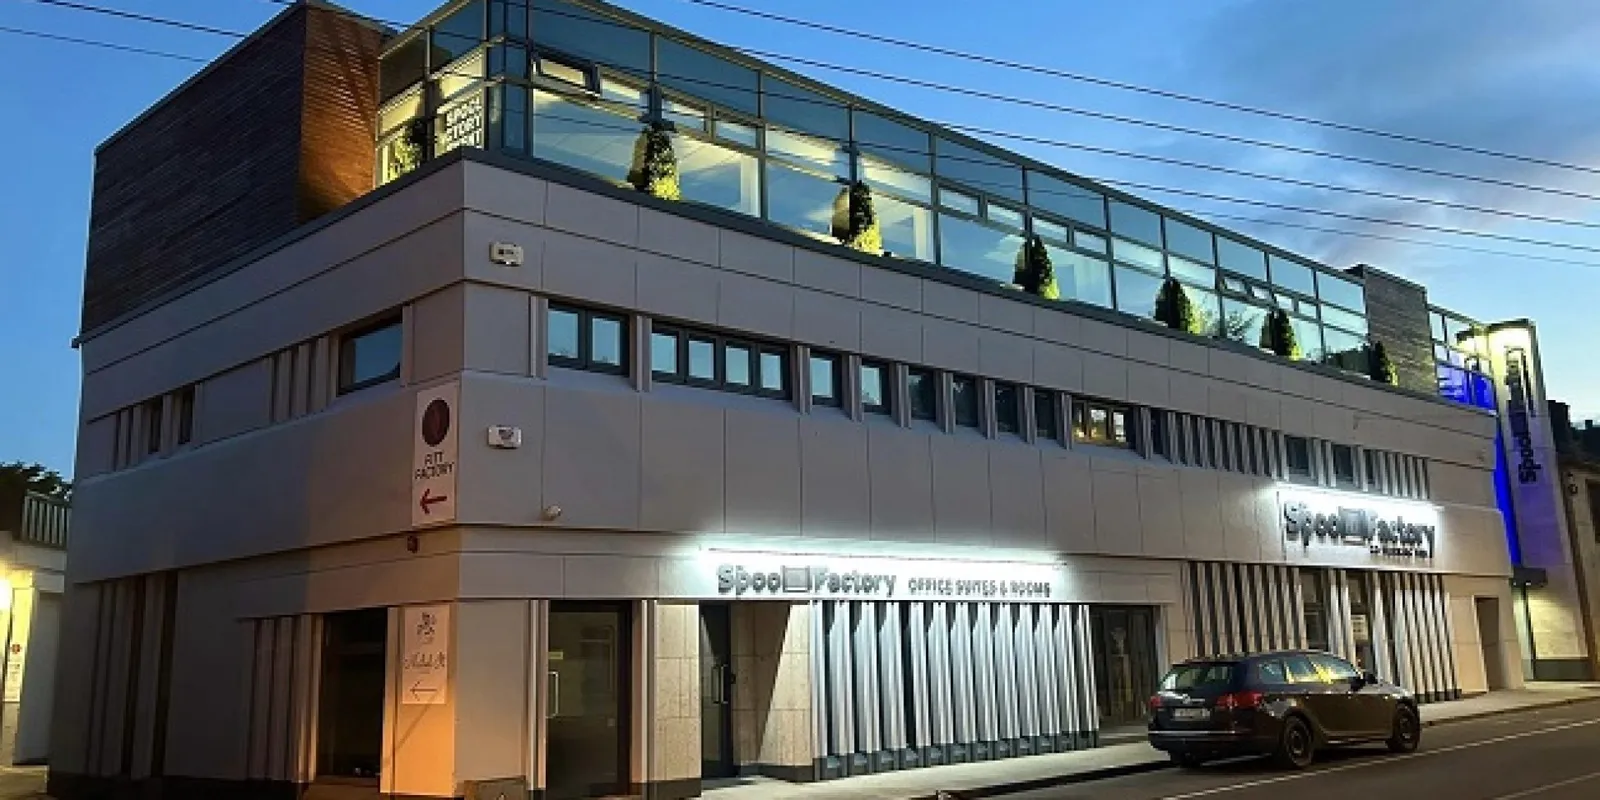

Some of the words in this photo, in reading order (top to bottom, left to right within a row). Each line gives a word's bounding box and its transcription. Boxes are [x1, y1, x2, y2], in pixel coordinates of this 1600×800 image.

[415, 462, 455, 480] FACTORY
[812, 567, 897, 598] Factory
[908, 577, 953, 596] OFFICE
[955, 579, 998, 597] SUITES
[1000, 580, 1008, 597] &
[1010, 581, 1051, 598] ROOMS
